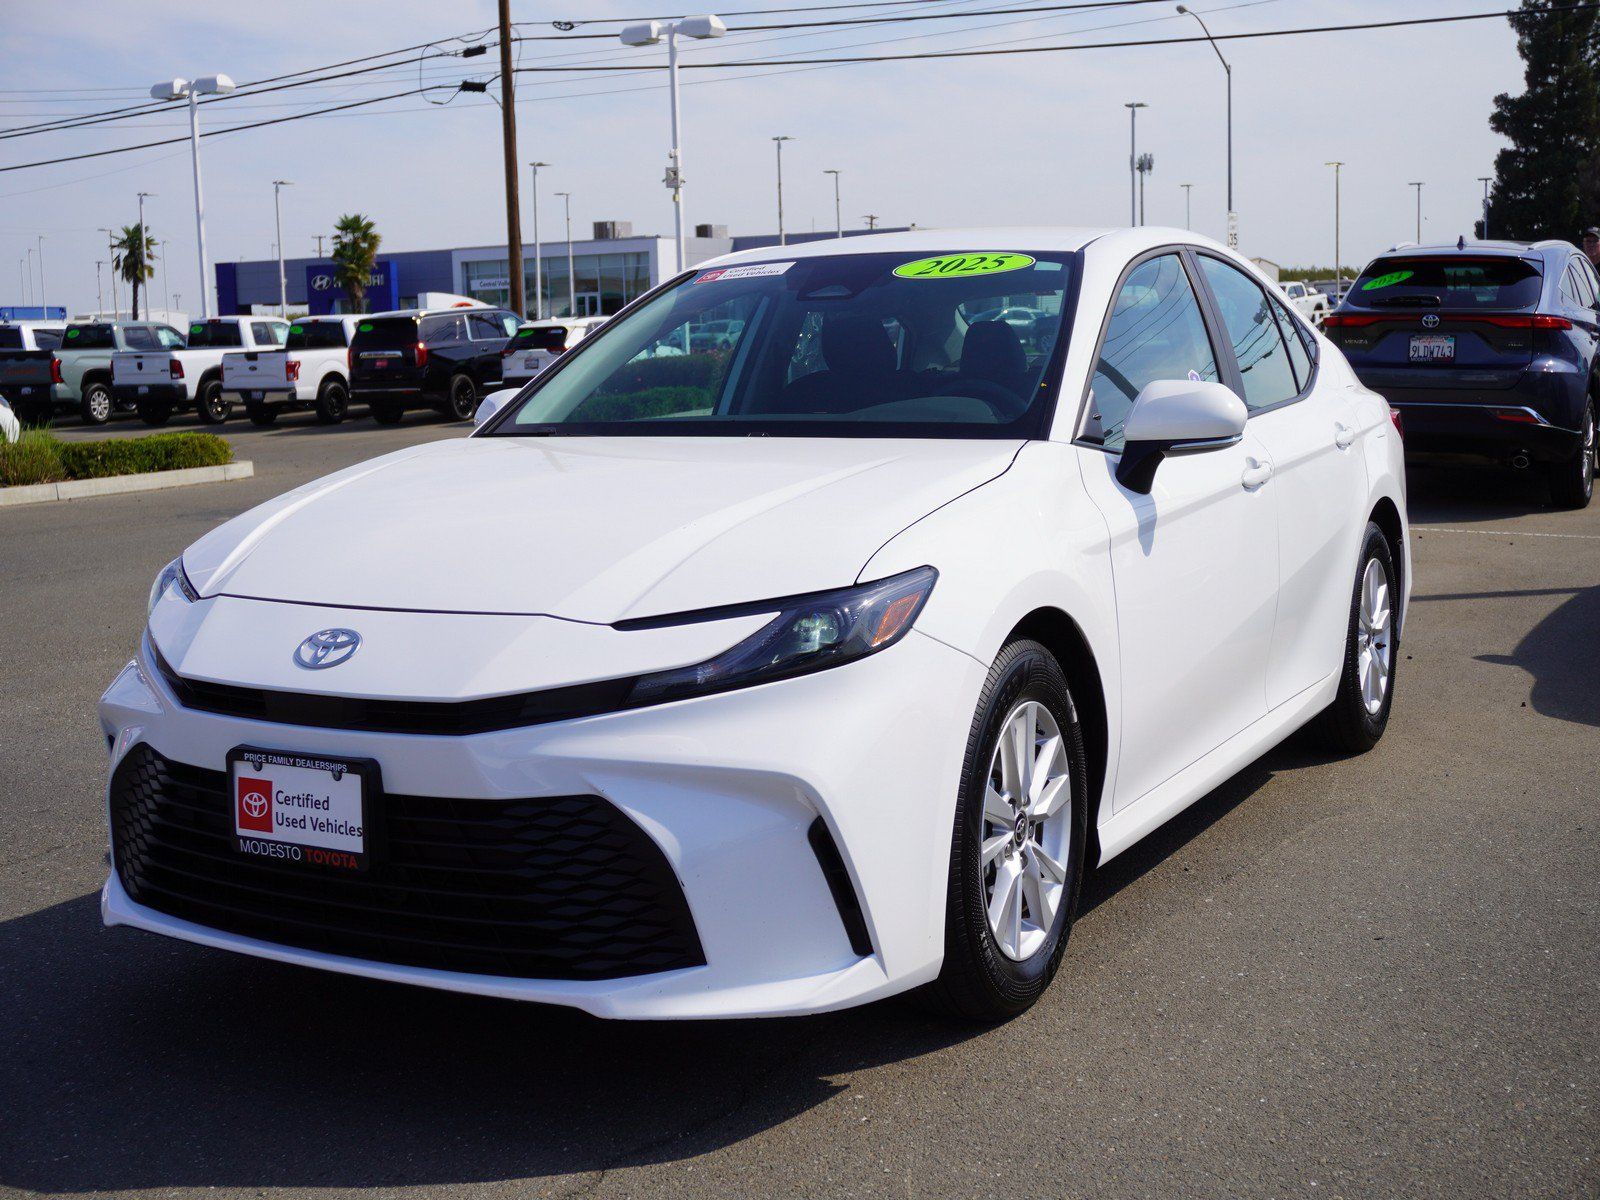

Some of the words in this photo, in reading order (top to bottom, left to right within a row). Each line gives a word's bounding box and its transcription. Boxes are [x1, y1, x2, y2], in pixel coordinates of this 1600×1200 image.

[913, 255, 1014, 276] 2025
[1344, 338, 1369, 346] VENZA
[244, 752, 267, 763] PRICE
[268, 754, 294, 766] FAMILY
[295, 758, 348, 773] DEALERSHIPS
[275, 790, 330, 811] Certified
[275, 812, 306, 830] Used
[310, 816, 363, 838] Vehicles
[239, 839, 301, 861] MODESTO
[304, 848, 359, 869] TOYOTA
